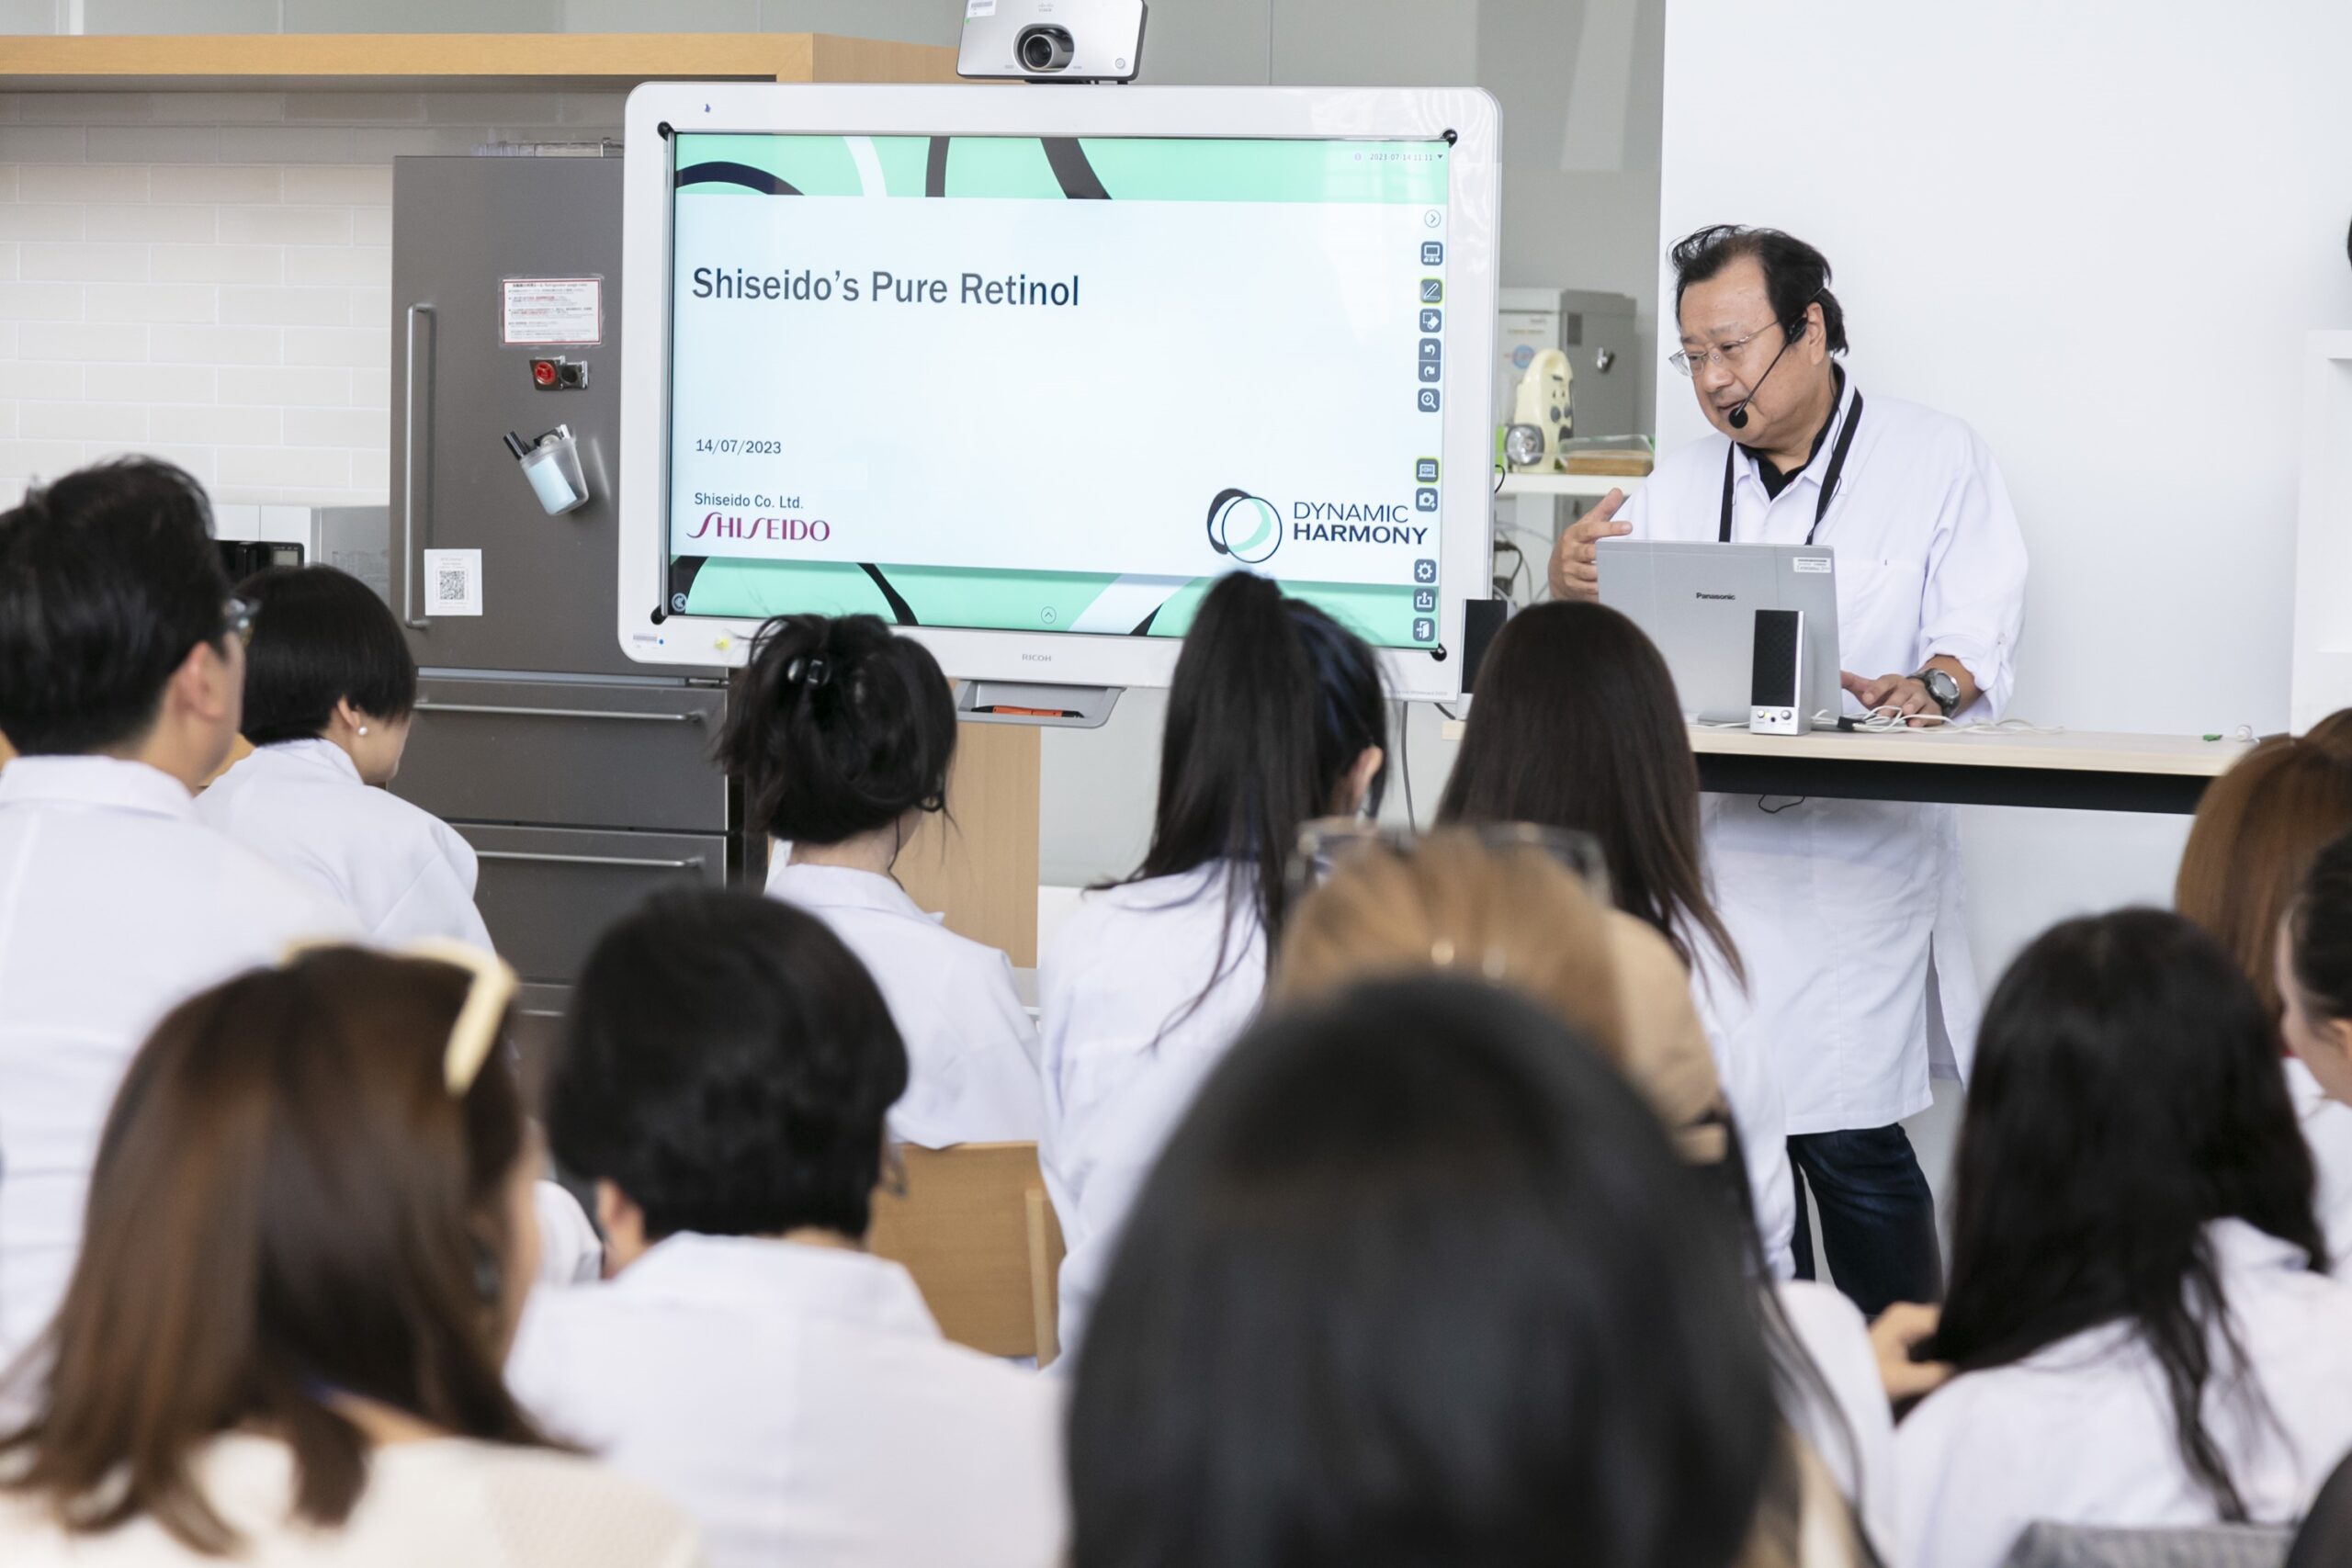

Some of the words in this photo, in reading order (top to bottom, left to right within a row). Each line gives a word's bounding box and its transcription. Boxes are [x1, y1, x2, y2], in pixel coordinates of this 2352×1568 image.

[692, 266, 860, 302] Shiseido’s
[871, 270, 948, 304] Pure
[960, 272, 1080, 306] Retinol
[695, 438, 782, 456] 14/07/2023
[695, 491, 751, 507] Shiseido
[753, 493, 775, 508] Co.
[779, 494, 804, 509] Ltd.
[1294, 502, 1409, 524] DYNAMIC
[686, 511, 831, 542] SHISEIDO
[1294, 523, 1429, 546] HARMONY
[1695, 592, 1736, 601] Panasonic
[1021, 653, 1052, 662] RICOH
